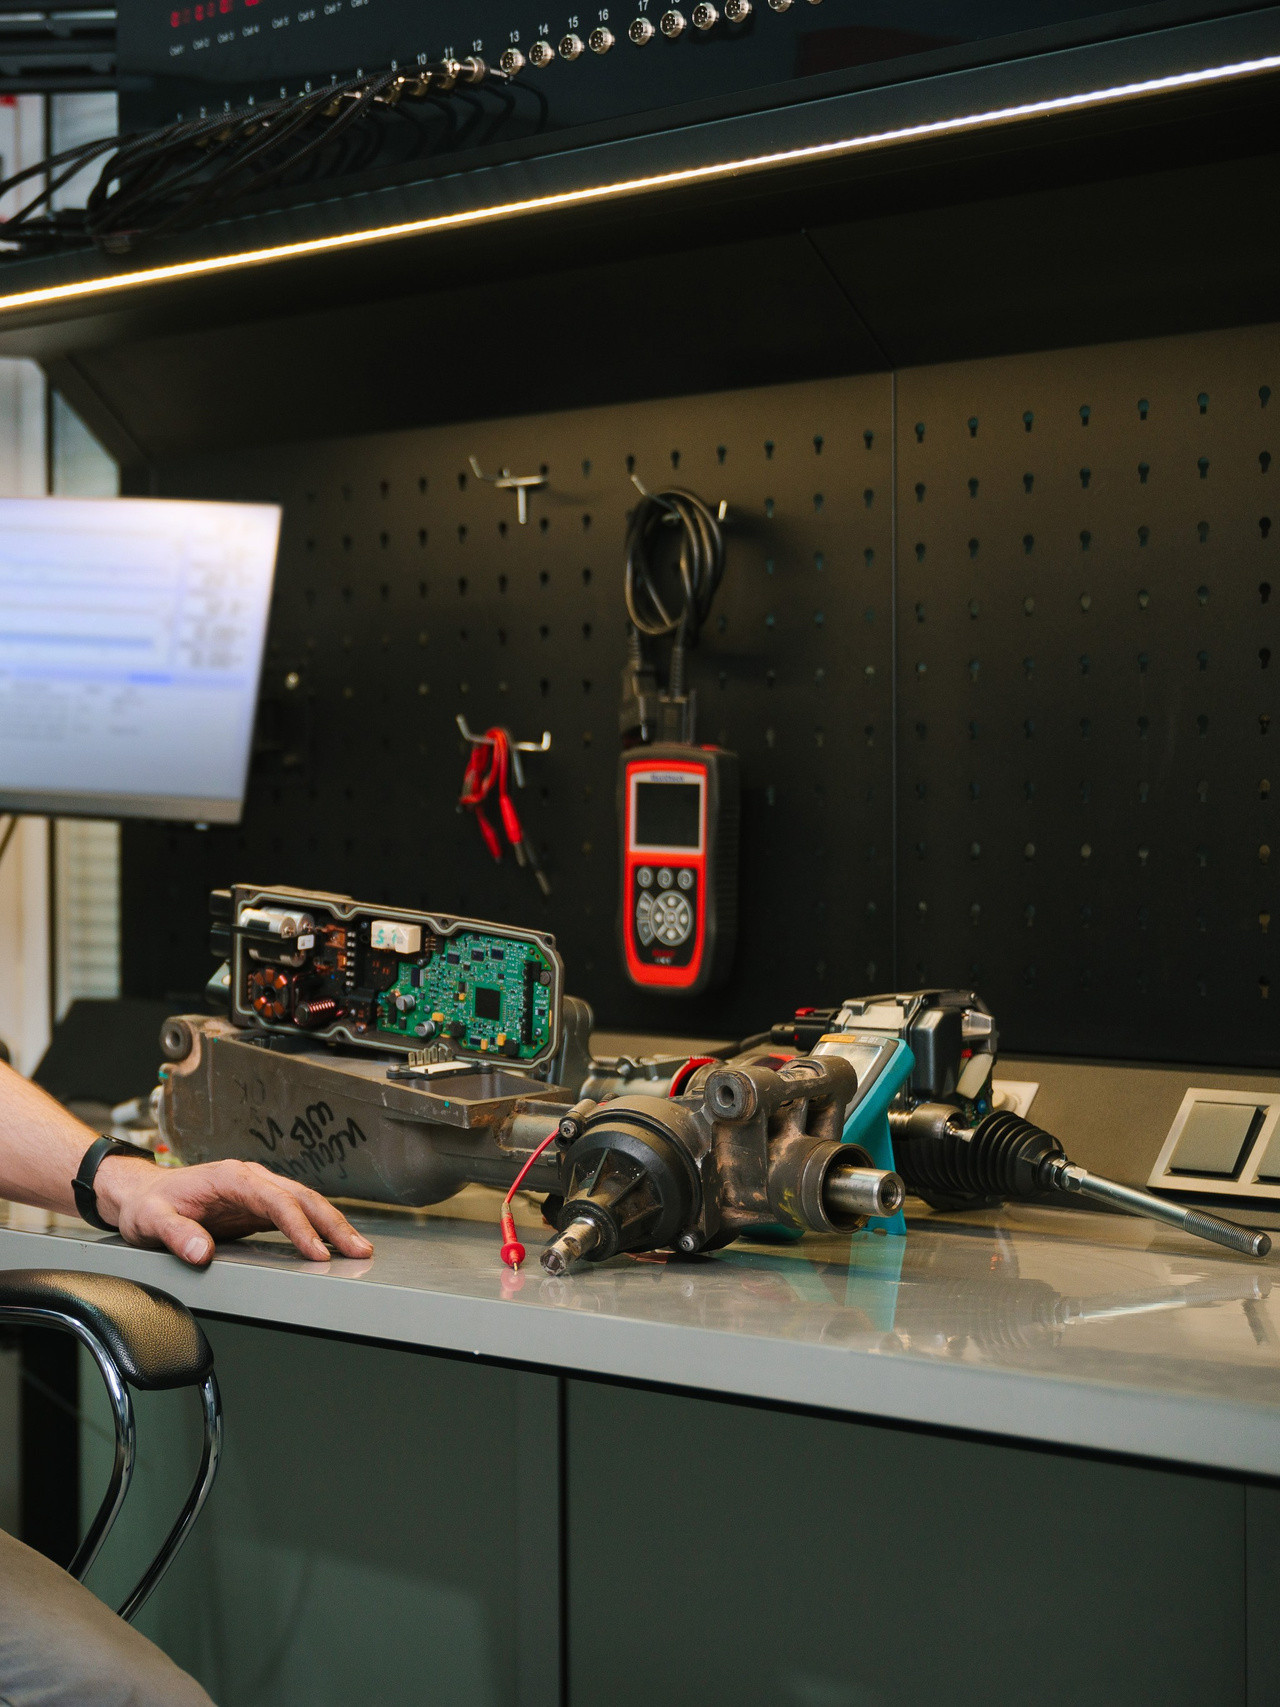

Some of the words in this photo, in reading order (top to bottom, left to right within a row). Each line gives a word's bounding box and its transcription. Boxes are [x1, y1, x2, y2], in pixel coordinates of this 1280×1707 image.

[391, 59, 398, 72] 9
[416, 52, 427, 65] 10
[444, 46, 454, 59] 11
[472, 38, 483, 52] 12
[509, 30, 520, 44] 13
[538, 23, 548, 36] 14
[568, 16, 578, 29] 15
[598, 8, 608, 22] 16
[638, 0, 648, 12] 17
